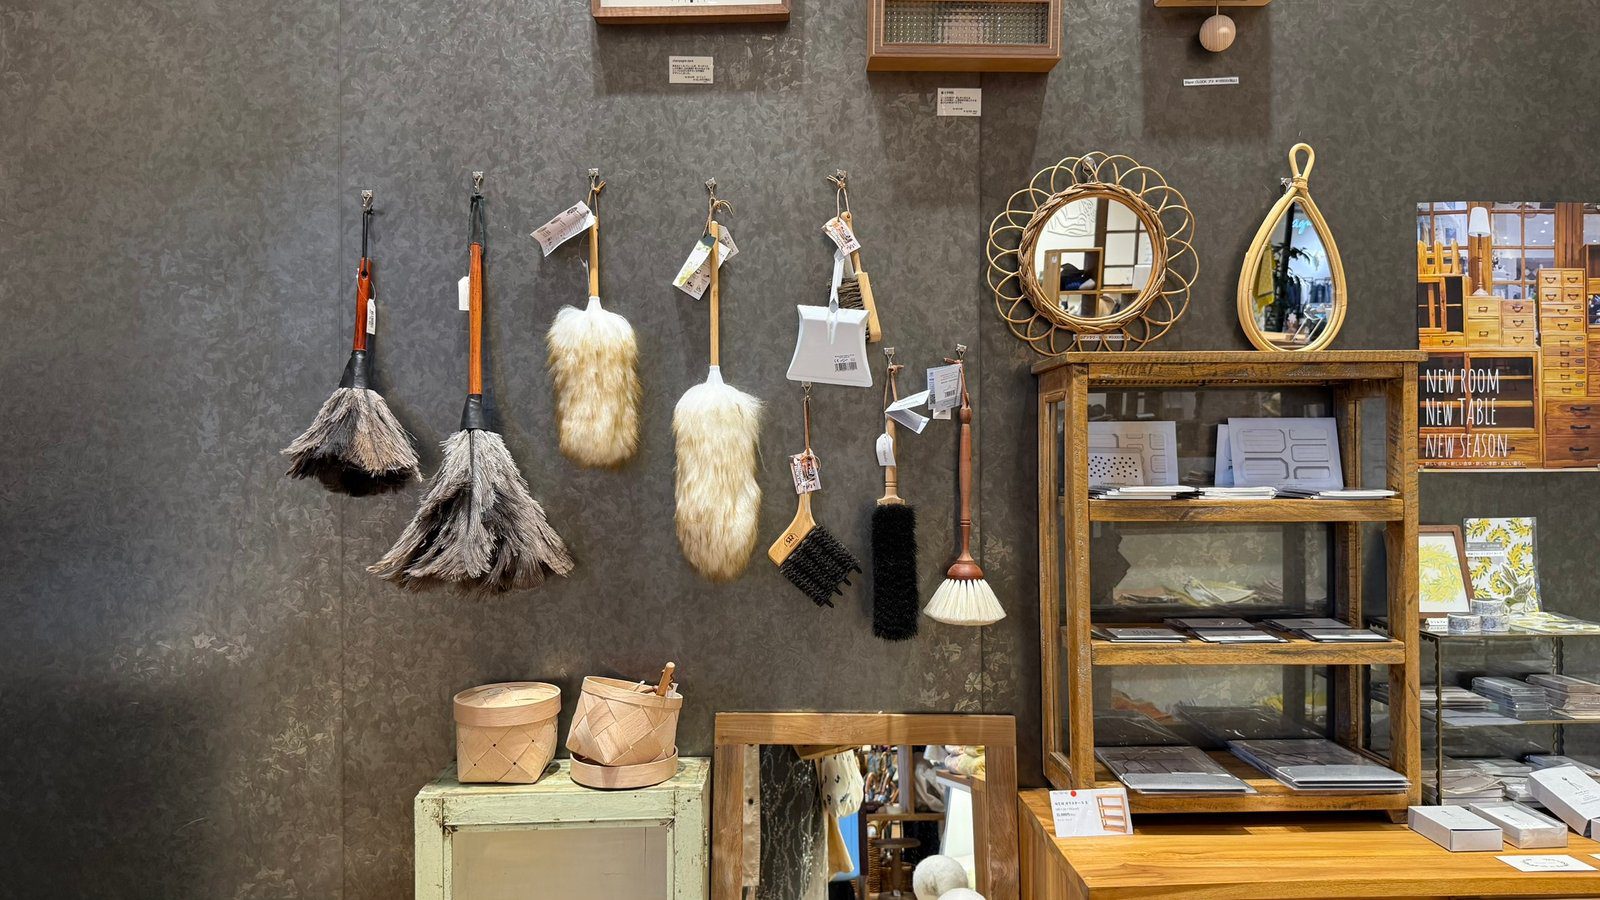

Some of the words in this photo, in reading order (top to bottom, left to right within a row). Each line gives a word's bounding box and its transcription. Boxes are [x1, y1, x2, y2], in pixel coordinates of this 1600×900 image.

[1425, 368, 1455, 394] NEW
[1460, 368, 1500, 394] ROOM
[1457, 397, 1497, 425] TABLE
[1425, 433, 1455, 458] NEW
[1459, 433, 1508, 458] SEASON
